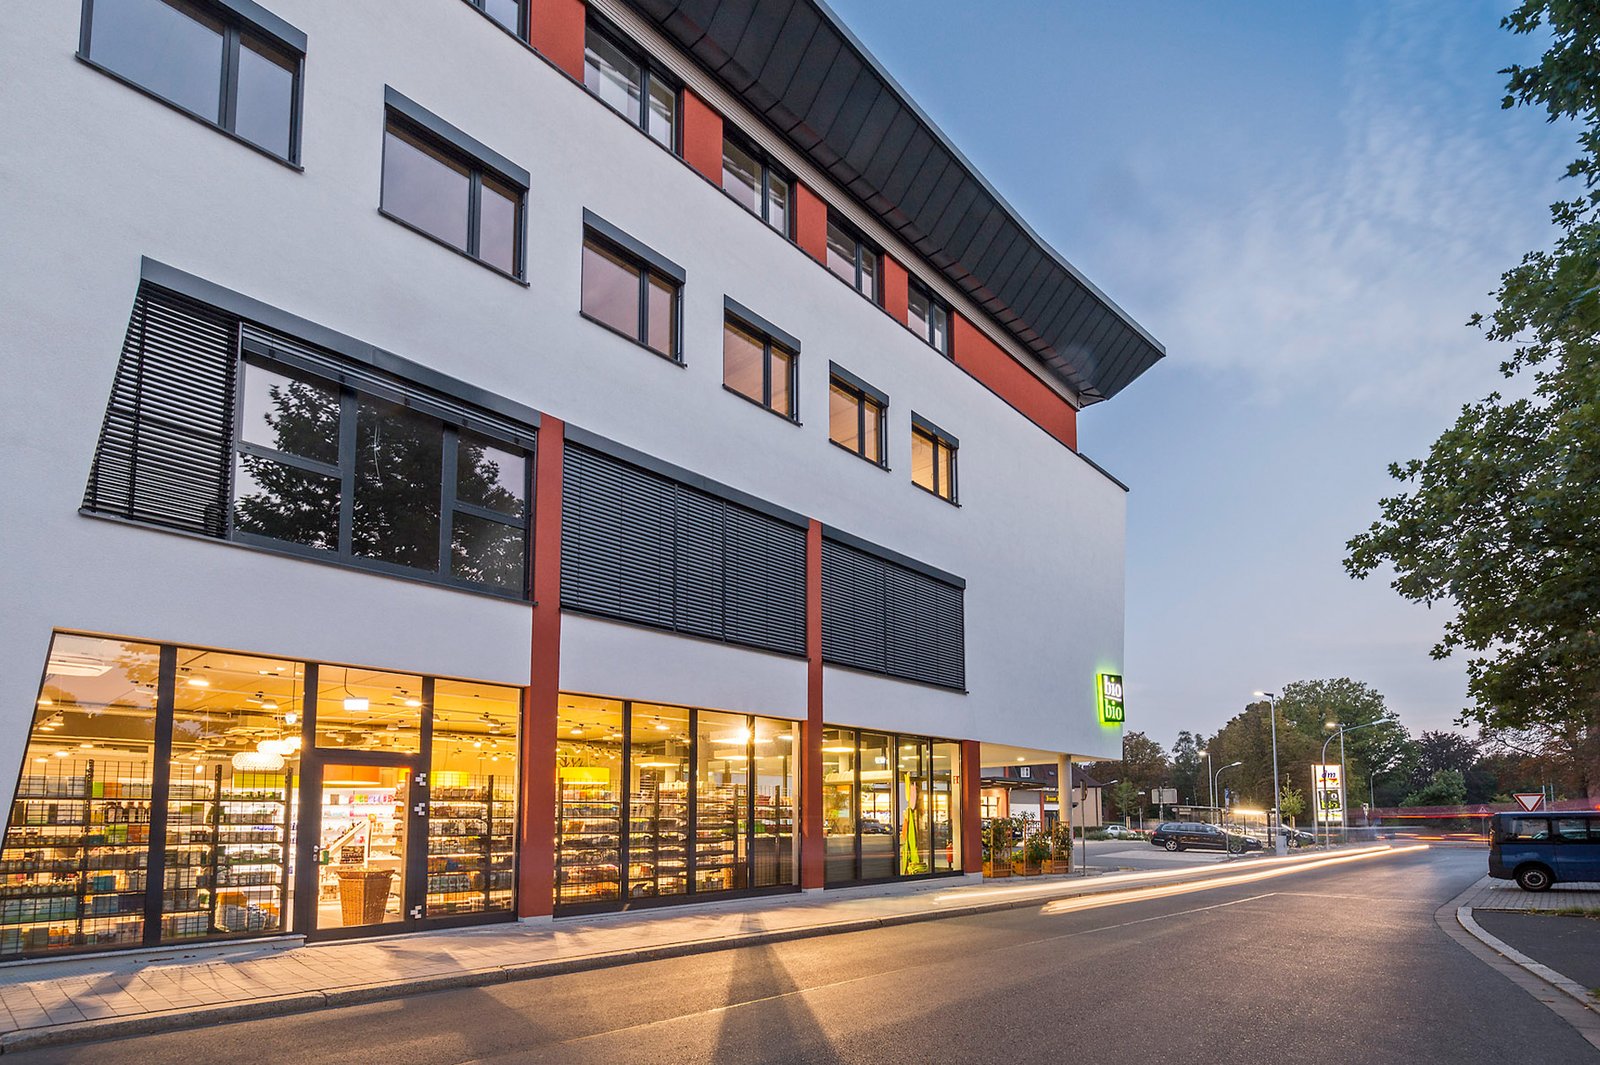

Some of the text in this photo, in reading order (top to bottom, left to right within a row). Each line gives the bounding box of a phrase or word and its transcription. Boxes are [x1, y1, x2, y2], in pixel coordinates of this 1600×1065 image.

[1103, 675, 1122, 698] bio
[1104, 699, 1122, 720] bio
[1321, 770, 1336, 778] dm
